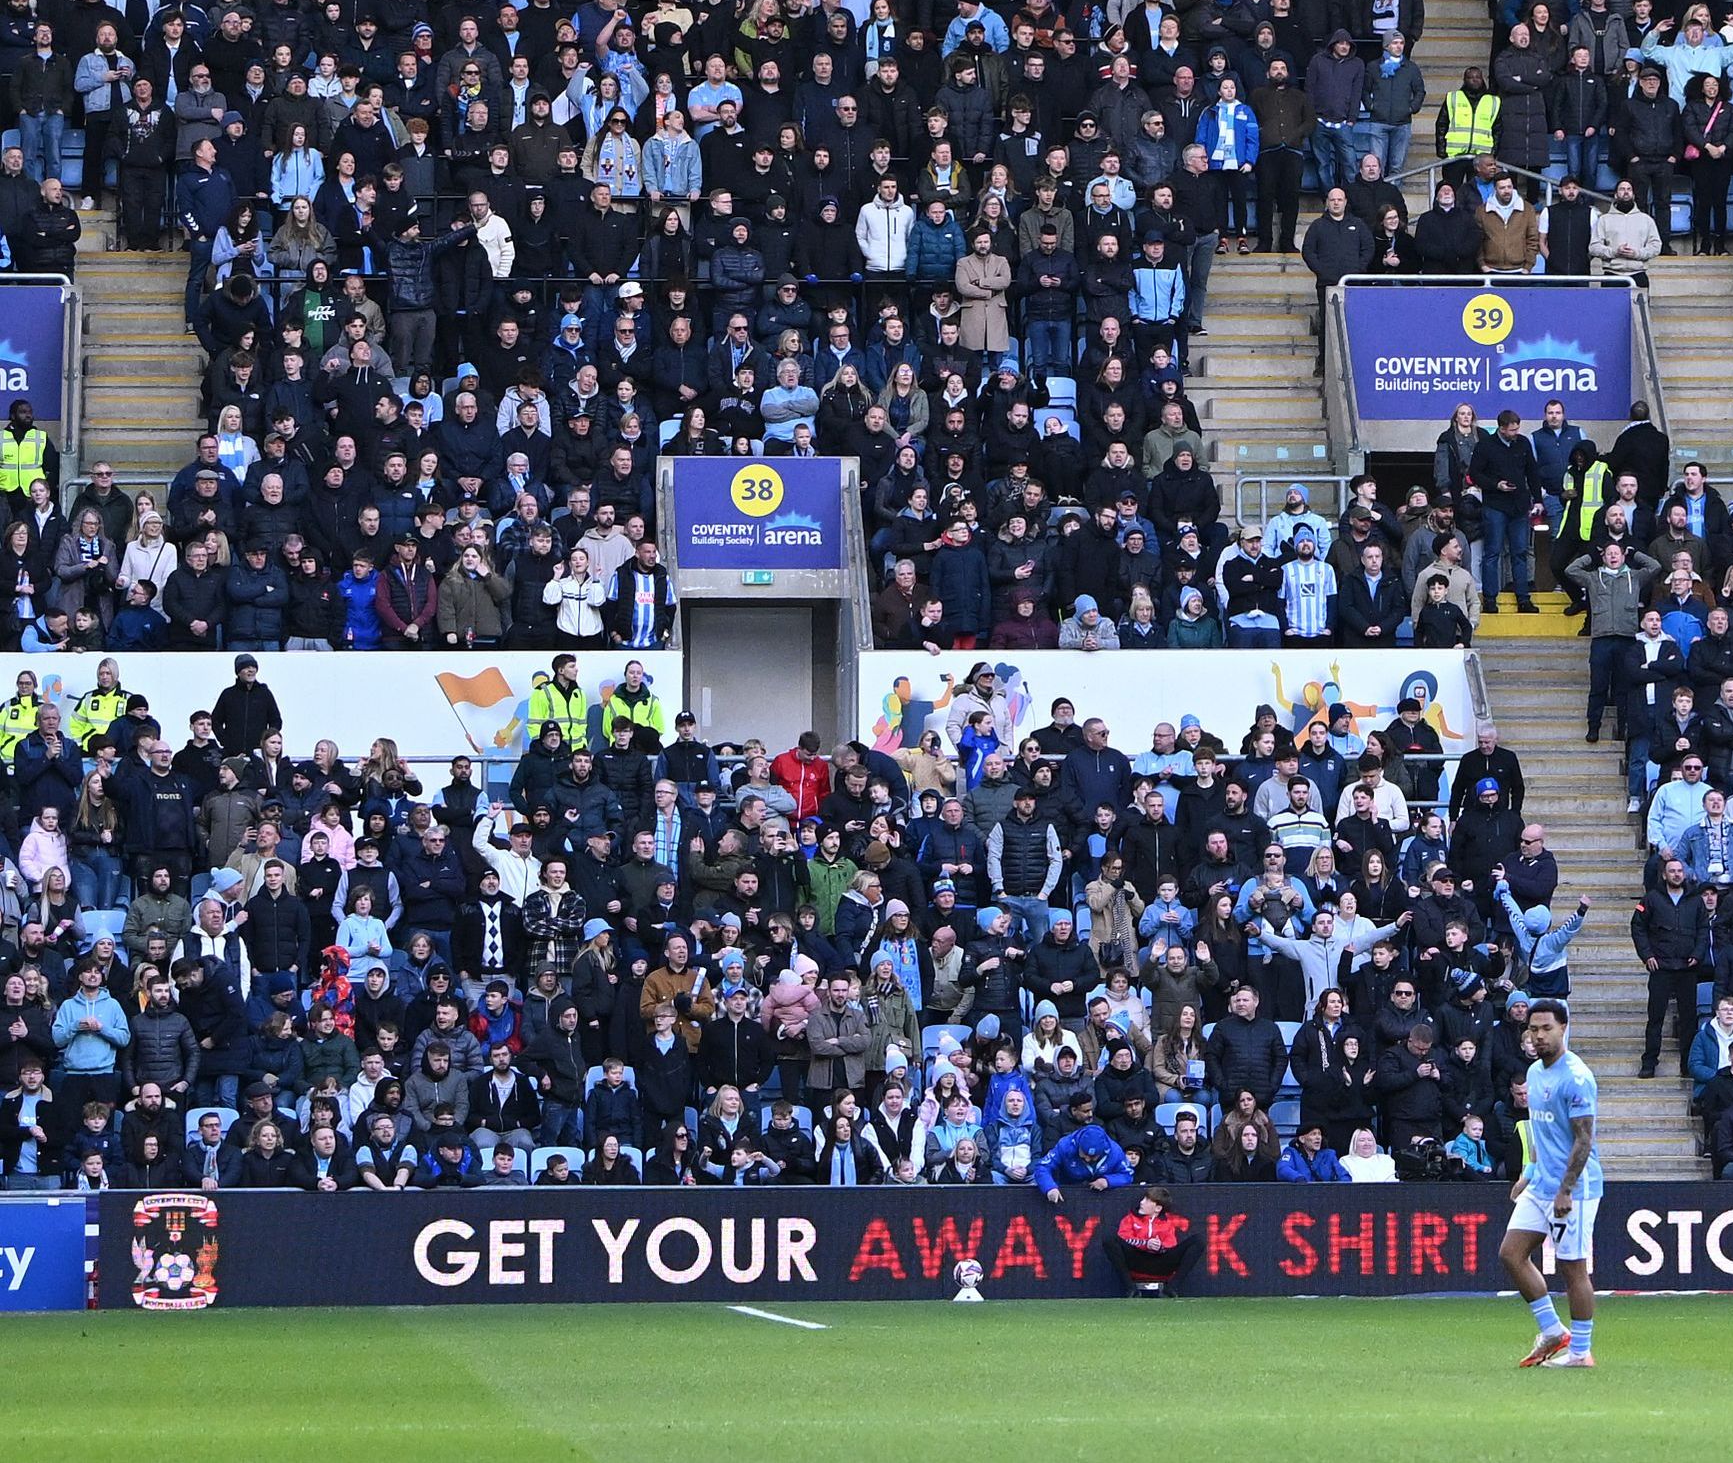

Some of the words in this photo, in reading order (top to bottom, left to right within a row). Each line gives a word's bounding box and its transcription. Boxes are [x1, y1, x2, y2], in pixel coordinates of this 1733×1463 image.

[1472, 307, 1504, 330] 39
[1375, 357, 1482, 376] COVENTRY
[1375, 378, 1430, 395] Building
[1433, 378, 1482, 395] Society
[1498, 367, 1598, 392] arena
[741, 478, 774, 501] 38
[691, 524, 755, 536] COVENTRY
[764, 529, 823, 546] arena
[691, 537, 724, 548] Building
[725, 537, 755, 548] Society
[413, 1219, 566, 1286] GET
[592, 1217, 818, 1283] YOUR
[848, 1215, 1101, 1282] AWAY
[1278, 1212, 1489, 1276] SHIRT
